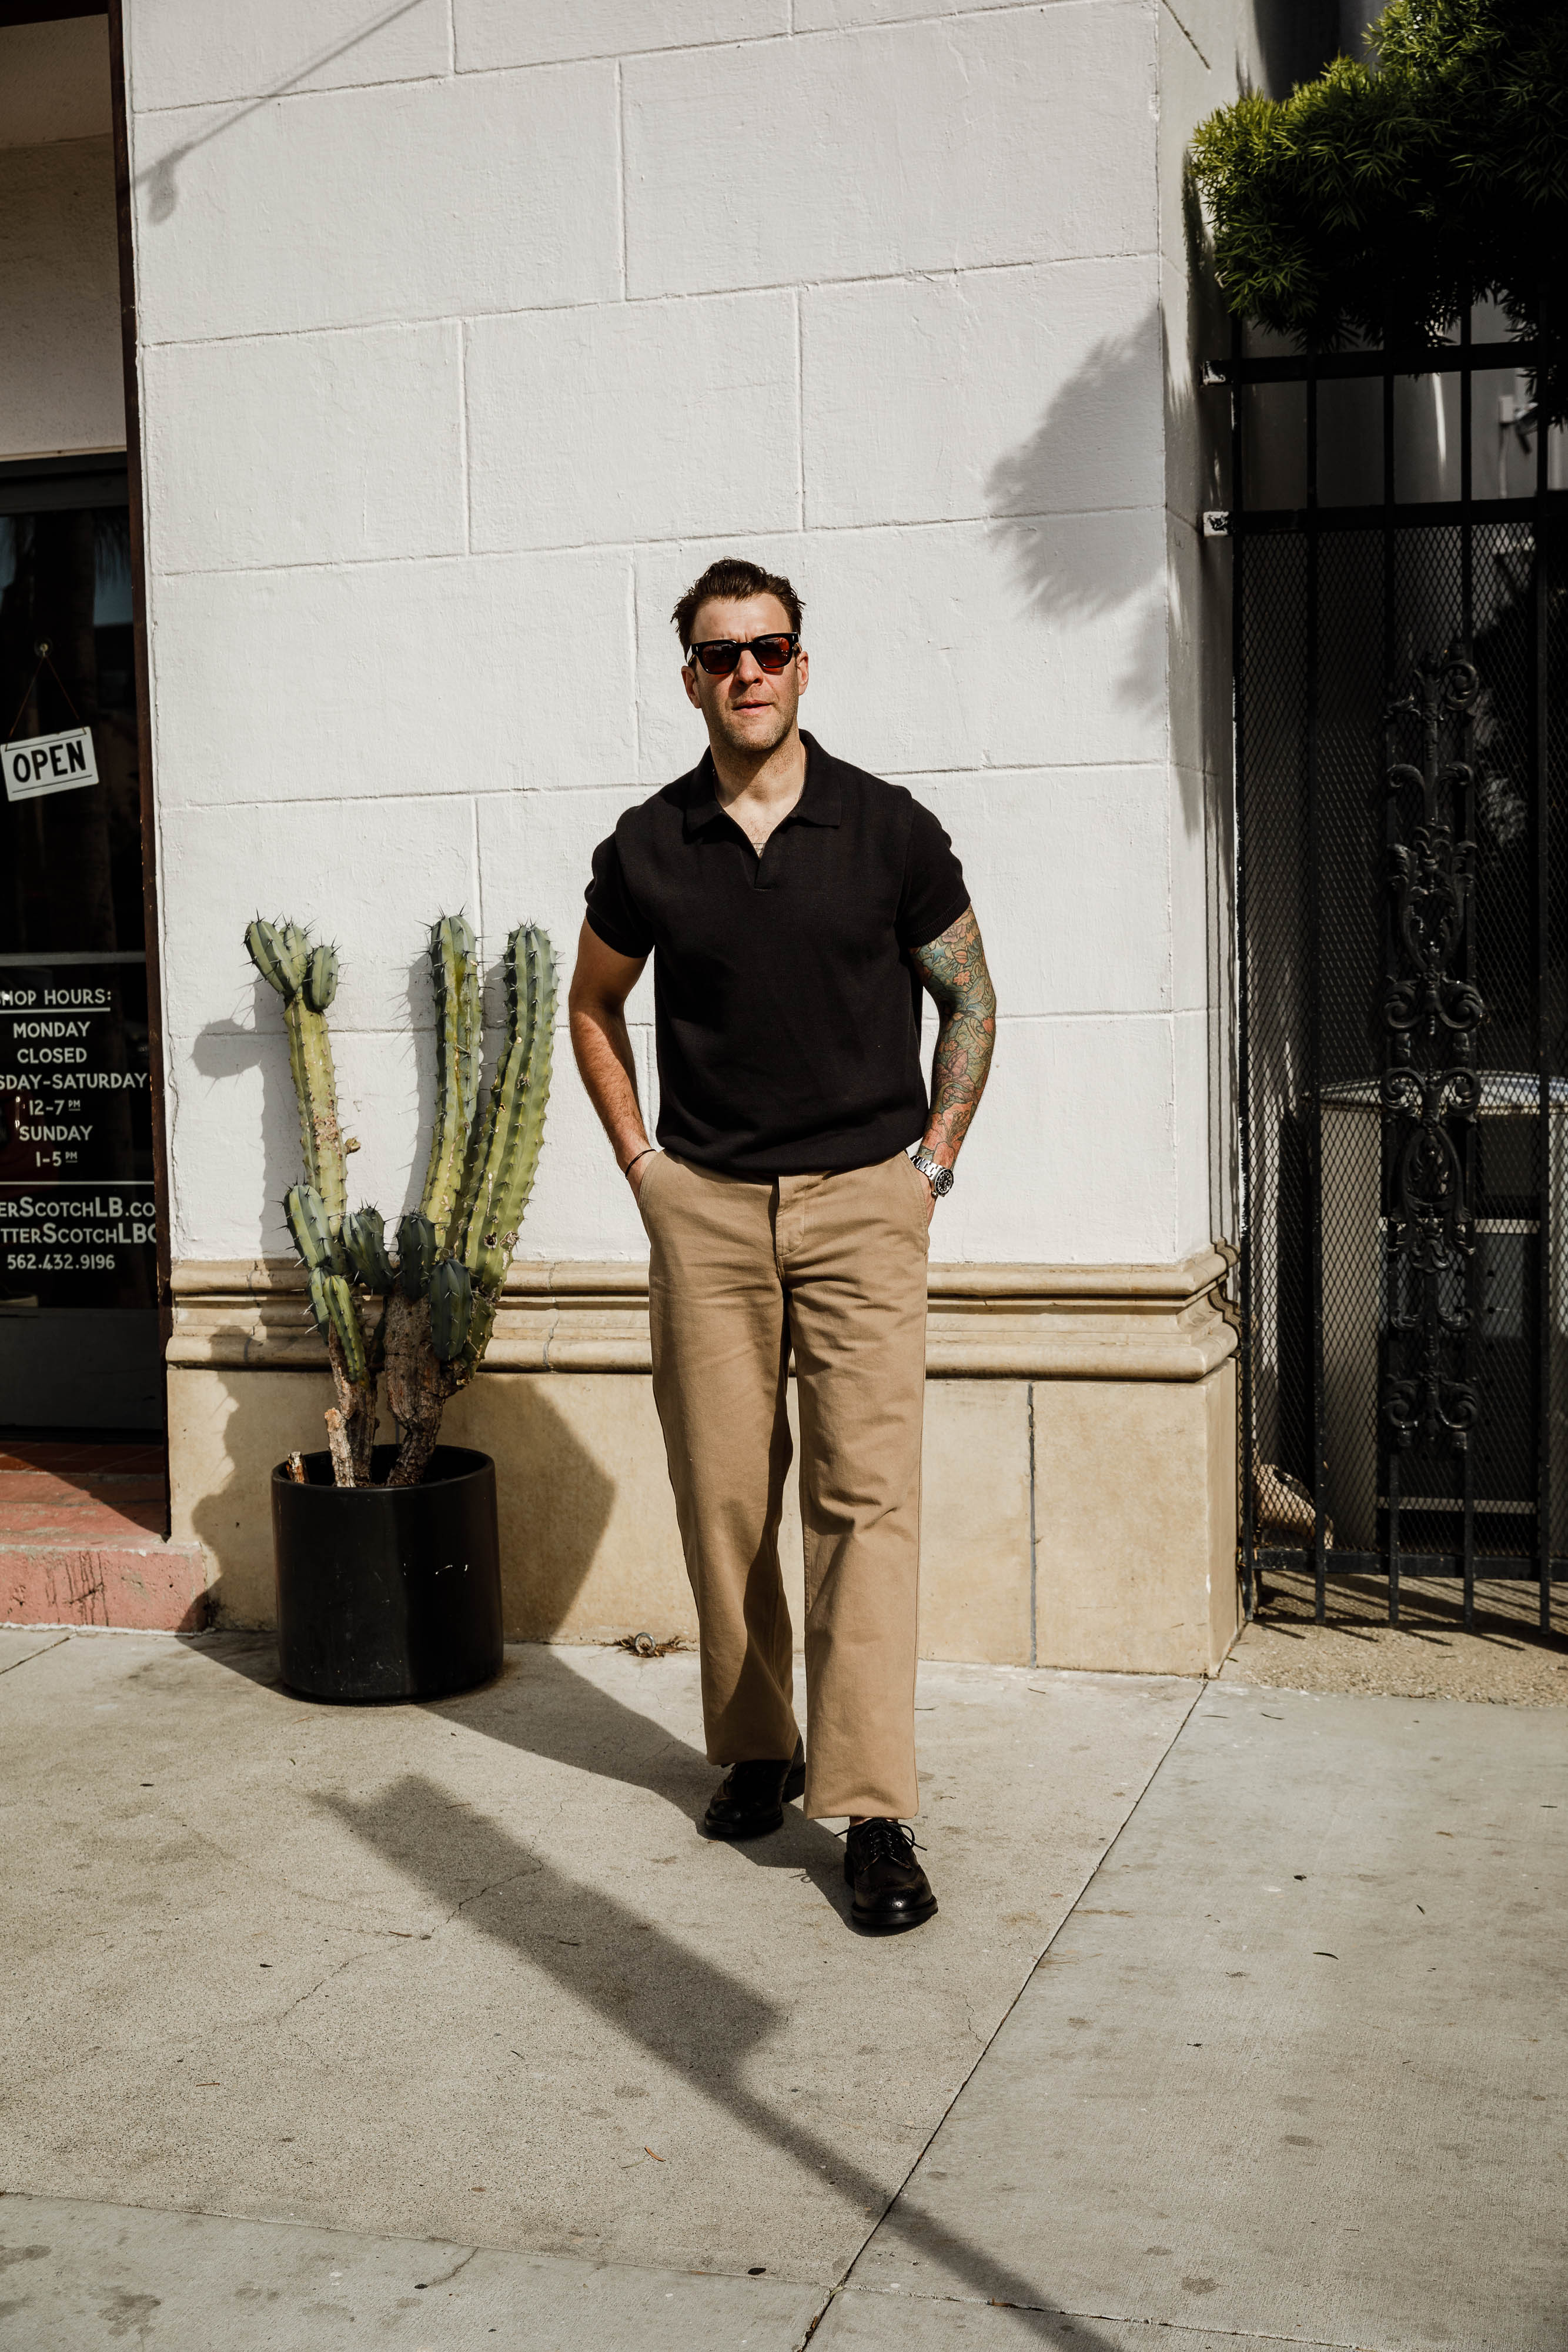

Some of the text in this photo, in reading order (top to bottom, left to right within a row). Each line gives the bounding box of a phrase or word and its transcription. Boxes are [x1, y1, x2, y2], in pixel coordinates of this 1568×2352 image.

[13, 740, 86, 783] OPEN
[0, 988, 111, 1005] HOP HOURS:
[13, 1021, 91, 1038] MONDAY
[17, 1048, 87, 1063] CLOSED
[29, 1100, 81, 1115] 12-7 PM
[19, 1125, 92, 1141] SUNDAY
[36, 1151, 78, 1167] 1-5 PM
[7, 1254, 115, 1270] 562.432.9196
